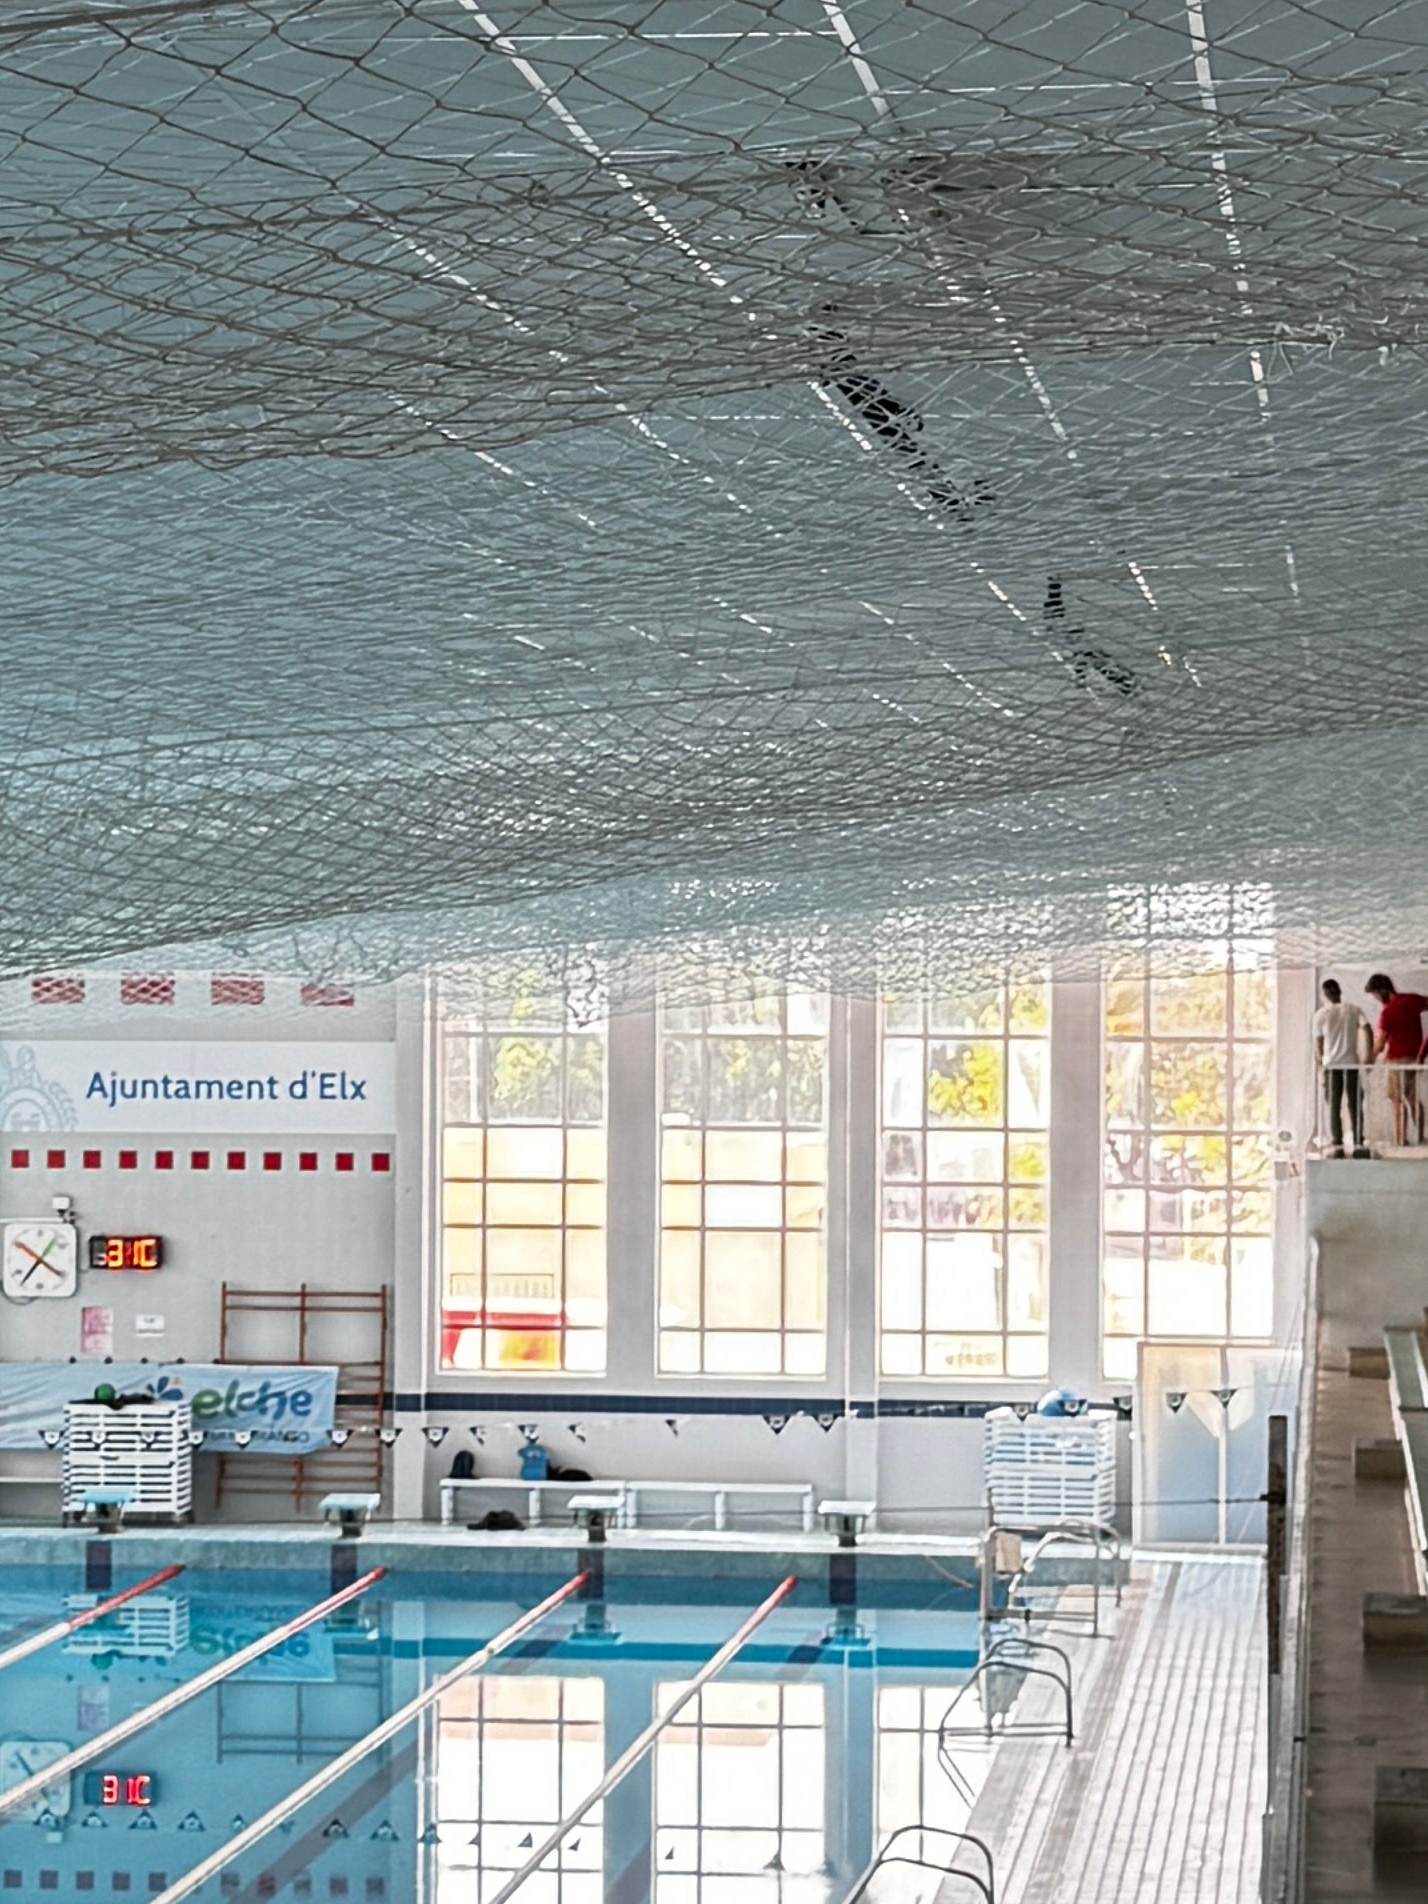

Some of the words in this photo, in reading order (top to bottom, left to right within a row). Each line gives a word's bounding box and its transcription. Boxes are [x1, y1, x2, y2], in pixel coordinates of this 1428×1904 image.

[86, 1070, 279, 1107] Ajuntament
[288, 1070, 367, 1100] d'Elx
[191, 1379, 314, 1420] elche
